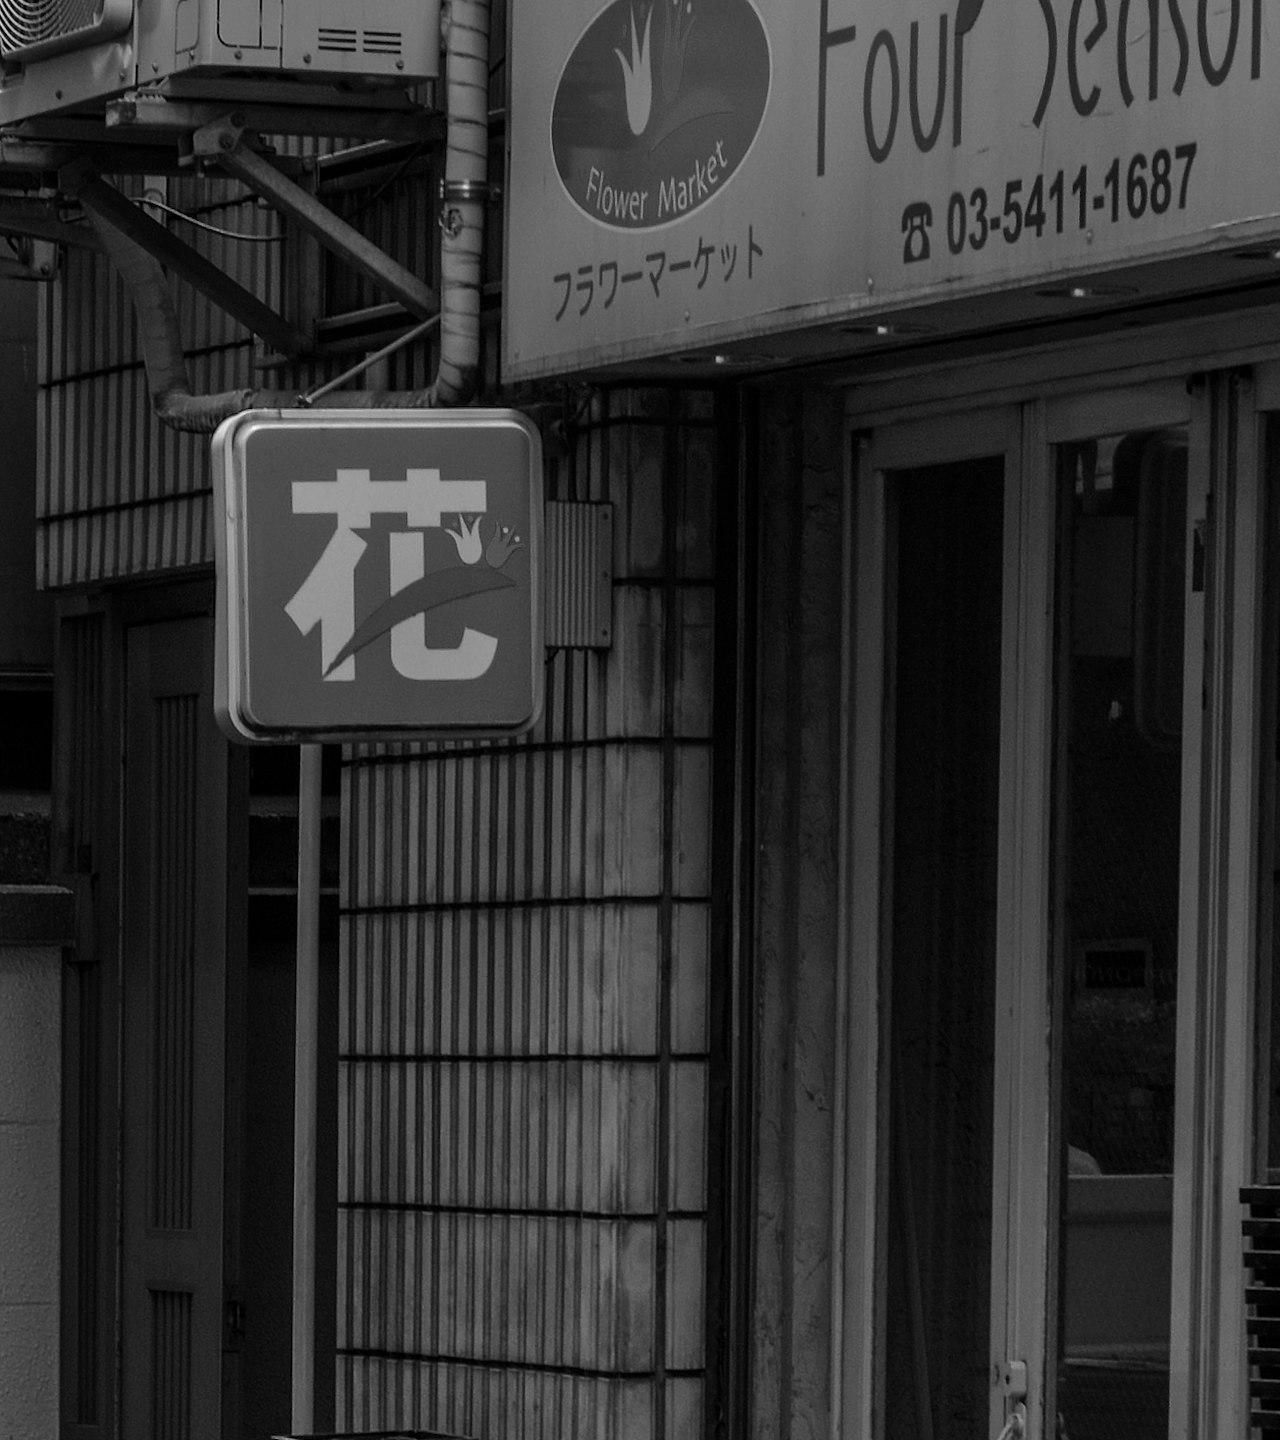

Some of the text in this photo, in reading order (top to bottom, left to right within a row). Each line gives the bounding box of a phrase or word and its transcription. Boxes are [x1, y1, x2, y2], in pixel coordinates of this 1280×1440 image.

[586, 139, 728, 221] Flower Market
[947, 143, 1198, 255] 03-5411-1687
[553, 224, 763, 322] フラワーマーケット
[283, 468, 499, 683] 花
